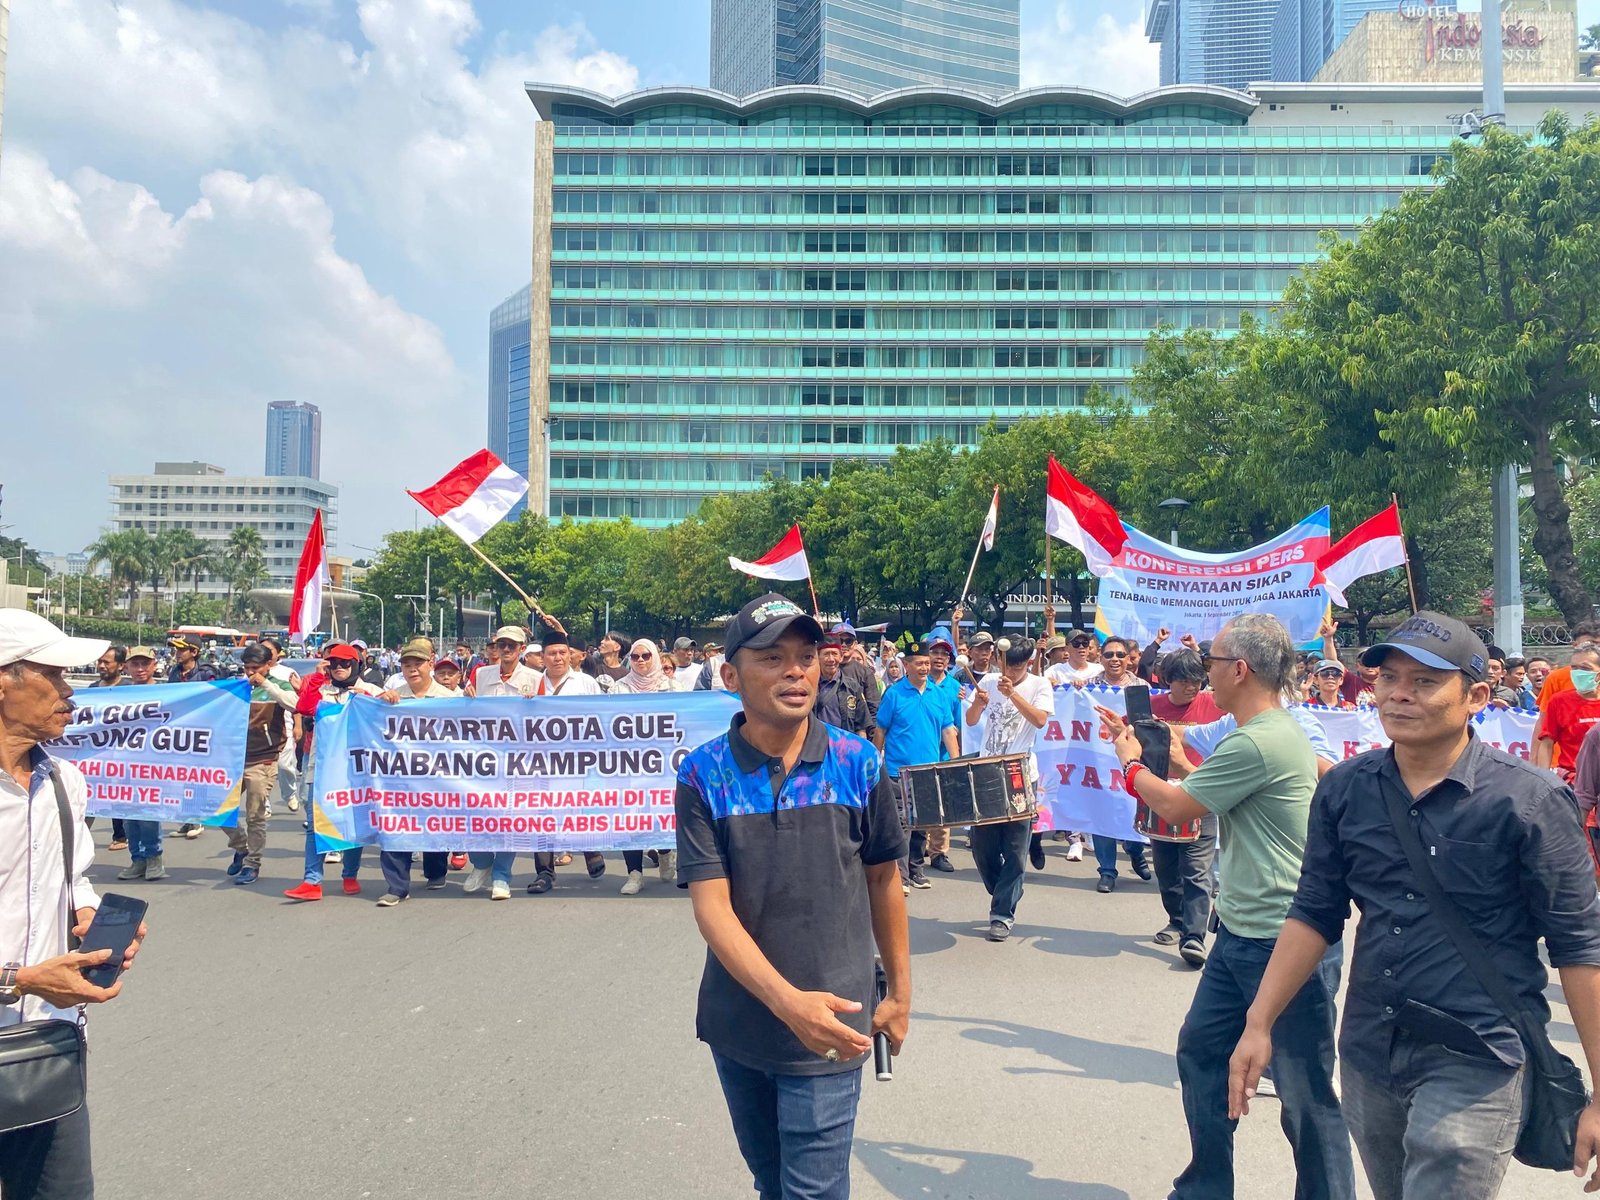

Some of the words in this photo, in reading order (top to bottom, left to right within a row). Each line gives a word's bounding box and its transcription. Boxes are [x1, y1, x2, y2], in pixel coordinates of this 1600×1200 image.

[1425, 11, 1547, 63] Indosia
[1440, 48, 1545, 62] KEMNSKI
[1125, 551, 1251, 575] KONFERENSI
[1256, 544, 1305, 570] PERS
[1136, 577, 1241, 593] PERNYATAAN
[1246, 571, 1292, 590] SIKAP
[1110, 590, 1158, 605] TENABANG
[1160, 598, 1219, 608] MEMANGGIL
[1221, 596, 1251, 607] UNTUK
[1253, 592, 1275, 603] JAGA
[1278, 588, 1321, 599] JAKARTA
[102, 702, 170, 723] GUE,
[384, 717, 517, 741] JAKARTA
[526, 717, 604, 742] KOTA
[612, 715, 683, 743] GUE,
[152, 729, 210, 753] GUE
[507, 750, 662, 776] KAMPUNG
[106, 763, 124, 777] DI
[130, 764, 232, 787] TENABANG,
[97, 784, 132, 800] LUH
[138, 787, 160, 803] YE
[467, 792, 508, 808] DAN
[514, 791, 616, 808] PENJARAH
[624, 790, 643, 806] DI
[427, 817, 466, 832] GUE
[472, 817, 556, 833] BORONG
[562, 815, 609, 832] ABIS
[615, 815, 652, 831] LUH
